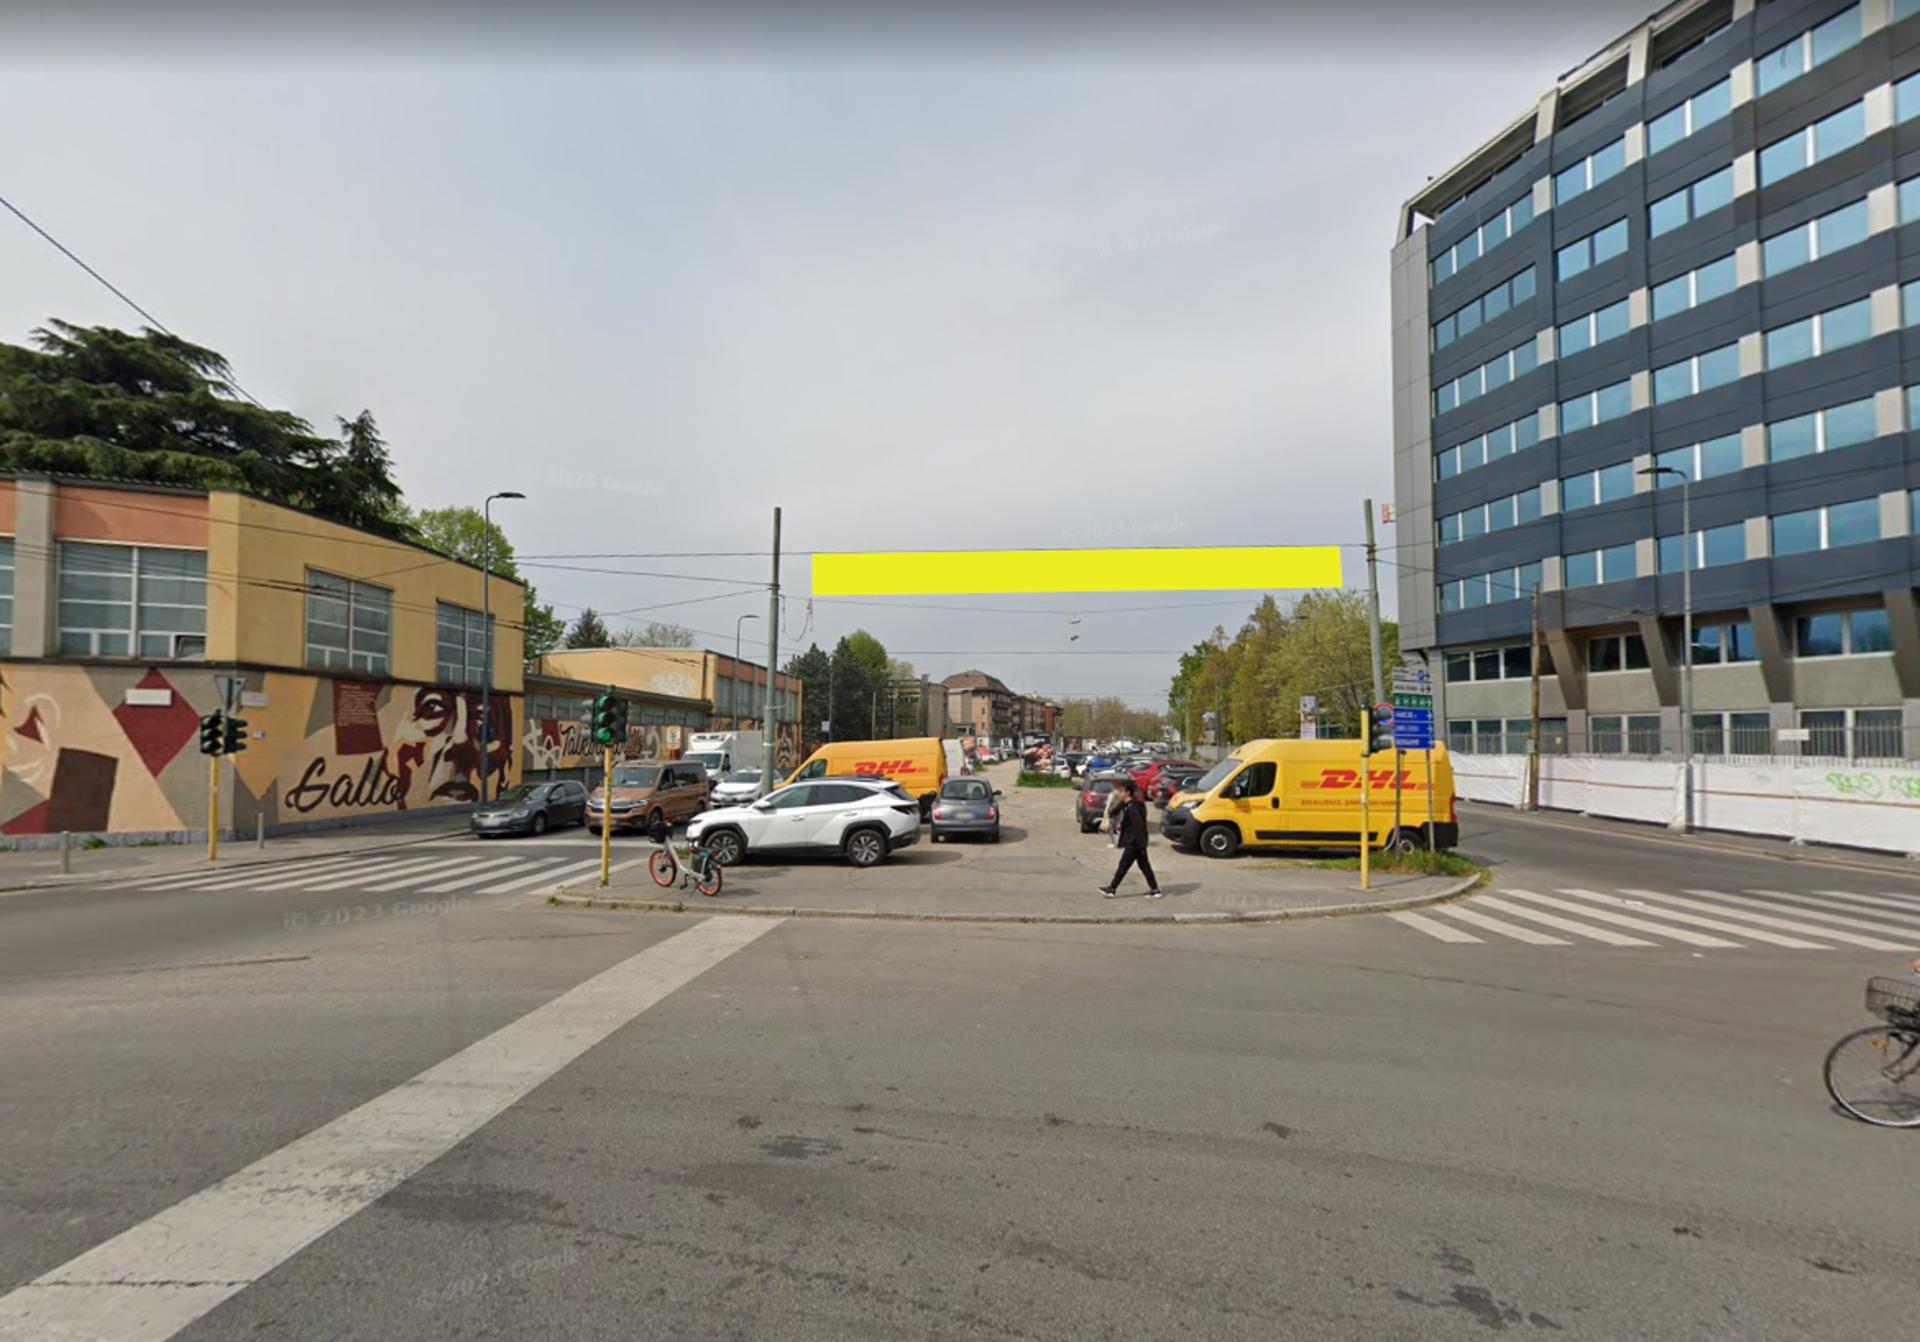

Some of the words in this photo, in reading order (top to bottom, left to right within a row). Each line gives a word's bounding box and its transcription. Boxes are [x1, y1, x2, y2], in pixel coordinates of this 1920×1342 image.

[854, 759, 919, 776] DHL
[285, 747, 400, 813] Gallo
[1319, 768, 1417, 790] DHL
